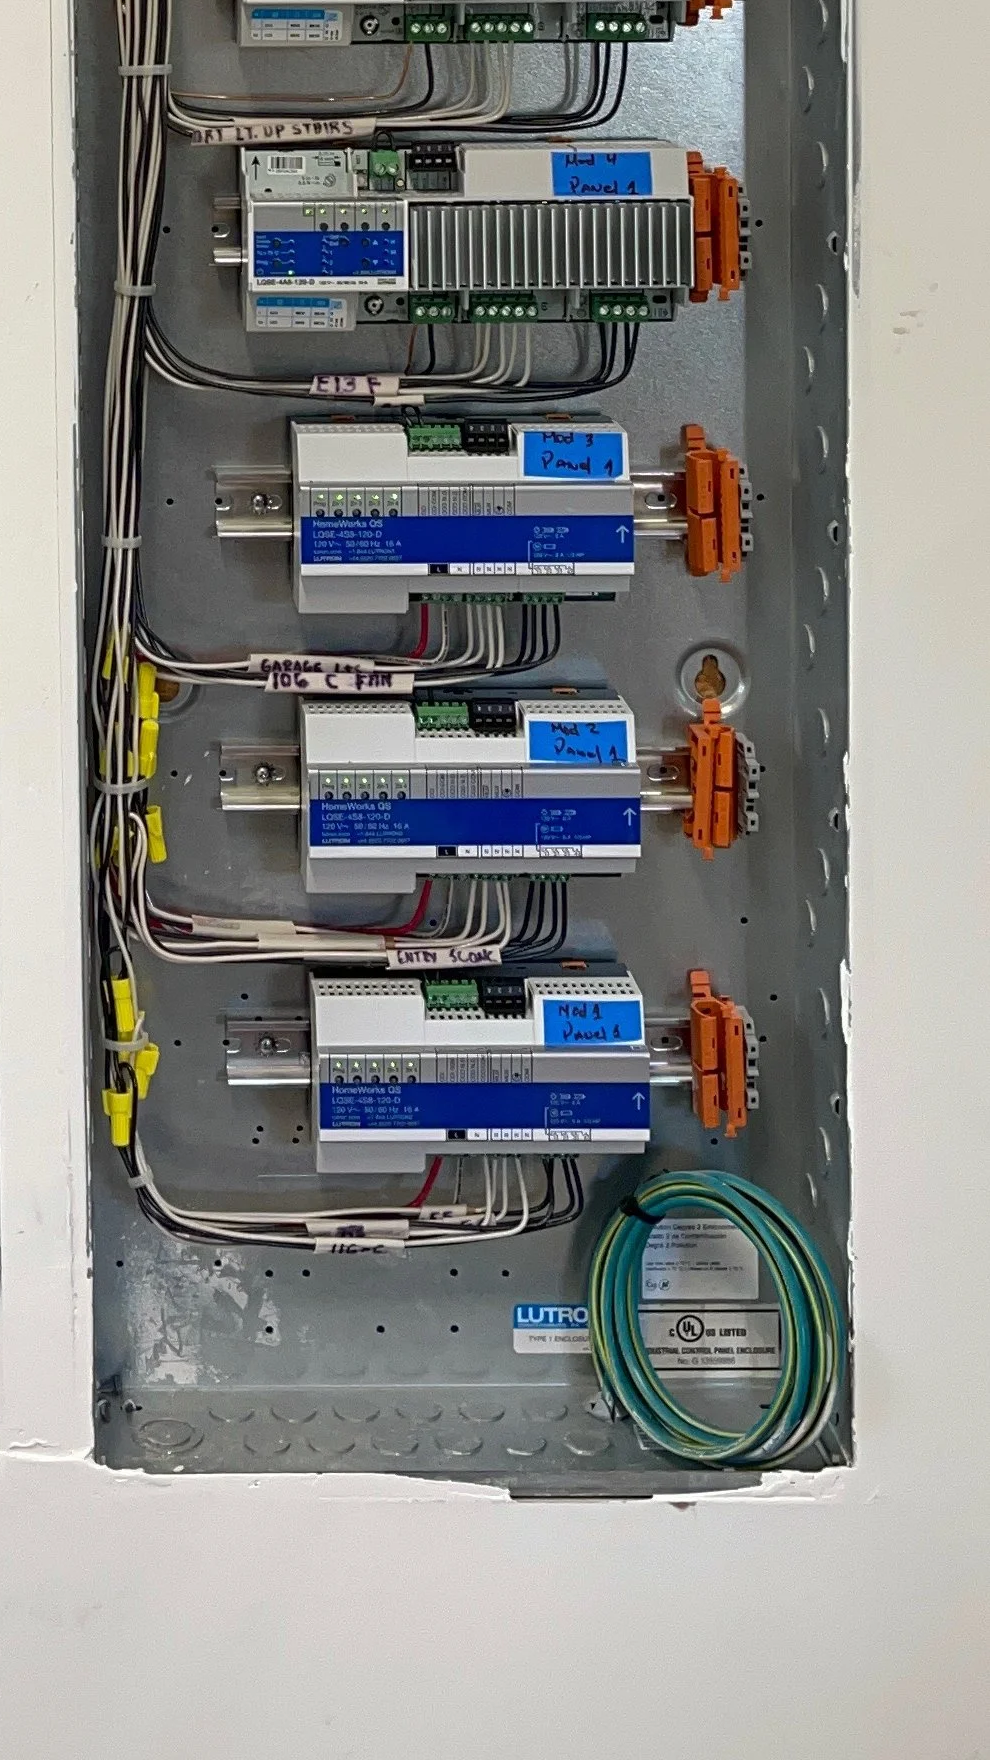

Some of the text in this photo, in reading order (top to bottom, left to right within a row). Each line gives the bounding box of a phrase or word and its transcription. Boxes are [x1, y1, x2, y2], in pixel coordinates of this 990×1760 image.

[263, 124, 286, 139] UP
[606, 152, 617, 165] 4
[627, 180, 639, 195] 1
[585, 433, 594, 447] 3
[603, 458, 614, 478] 1
[312, 520, 367, 528] HomeWorks
[273, 672, 392, 690] 106 C FAN
[585, 722, 600, 735] 2
[609, 745, 627, 763] 1
[321, 802, 376, 811] HomeWorks
[331, 1086, 386, 1094] HomeWorks
[517, 1306, 589, 1323] LUTRO
[719, 1328, 747, 1337] LISTED
[681, 1346, 712, 1354] CONTROL
[713, 1346, 735, 1354] PANEL
[736, 1346, 776, 1354] ENCLOSURE
